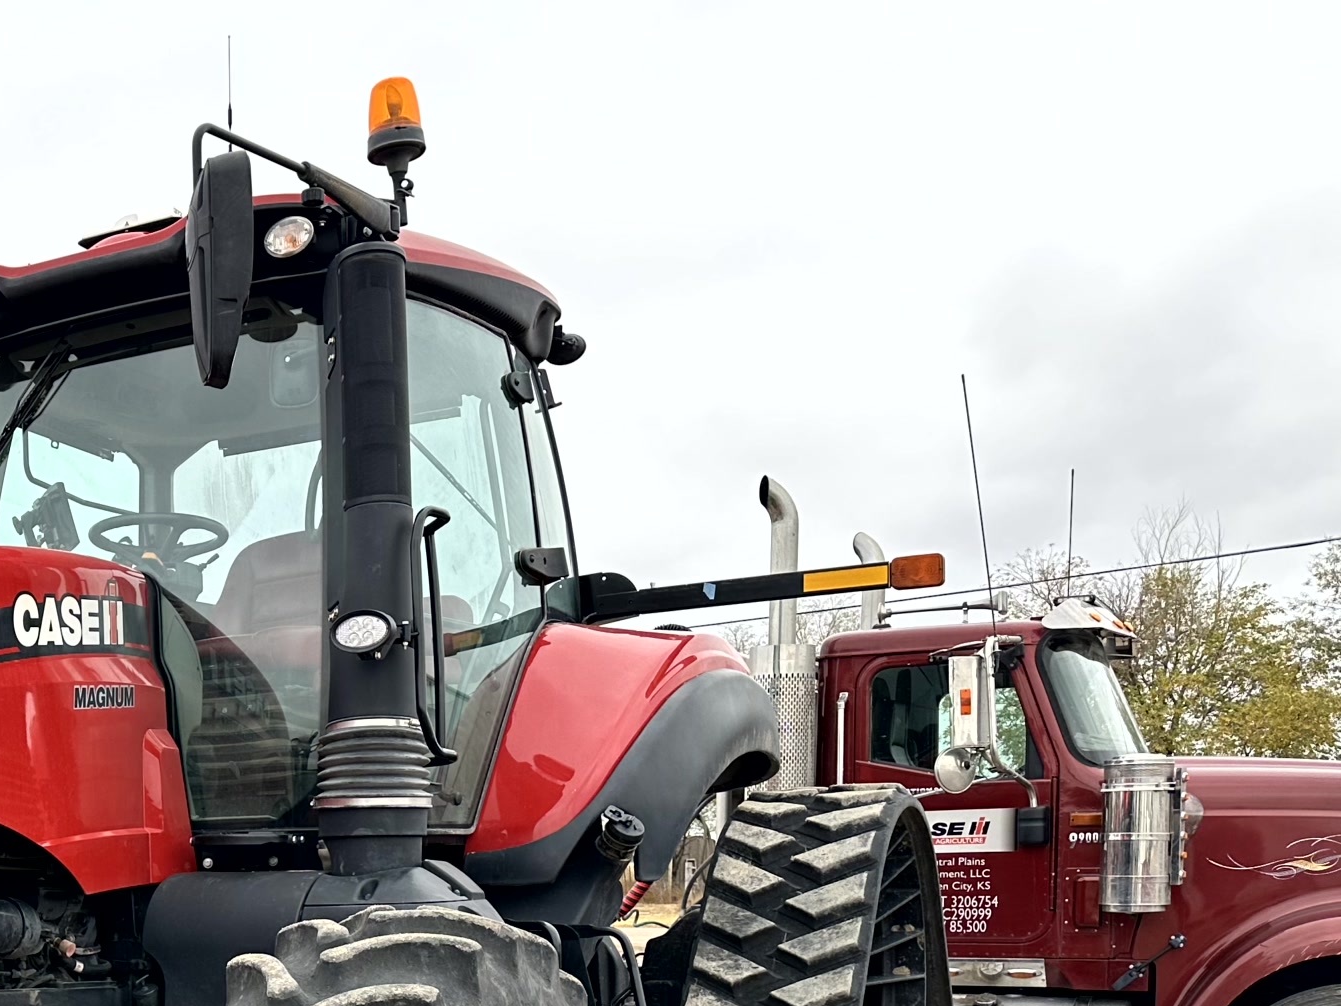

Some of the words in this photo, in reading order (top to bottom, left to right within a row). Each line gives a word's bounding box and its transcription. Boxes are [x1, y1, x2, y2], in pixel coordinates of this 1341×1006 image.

[13, 593, 100, 647] CASE
[73, 685, 135, 710] MAGNUM
[931, 822, 966, 836] SE
[935, 837, 983, 845] AGRICULTURE
[958, 857, 986, 867] Plains
[939, 870, 967, 879] ment,
[970, 868, 991, 878] LLC
[951, 881, 974, 892] City,
[977, 881, 991, 890] KS
[951, 895, 999, 908] 3206754
[942, 907, 992, 920] C290999
[949, 920, 987, 934] 85,500
